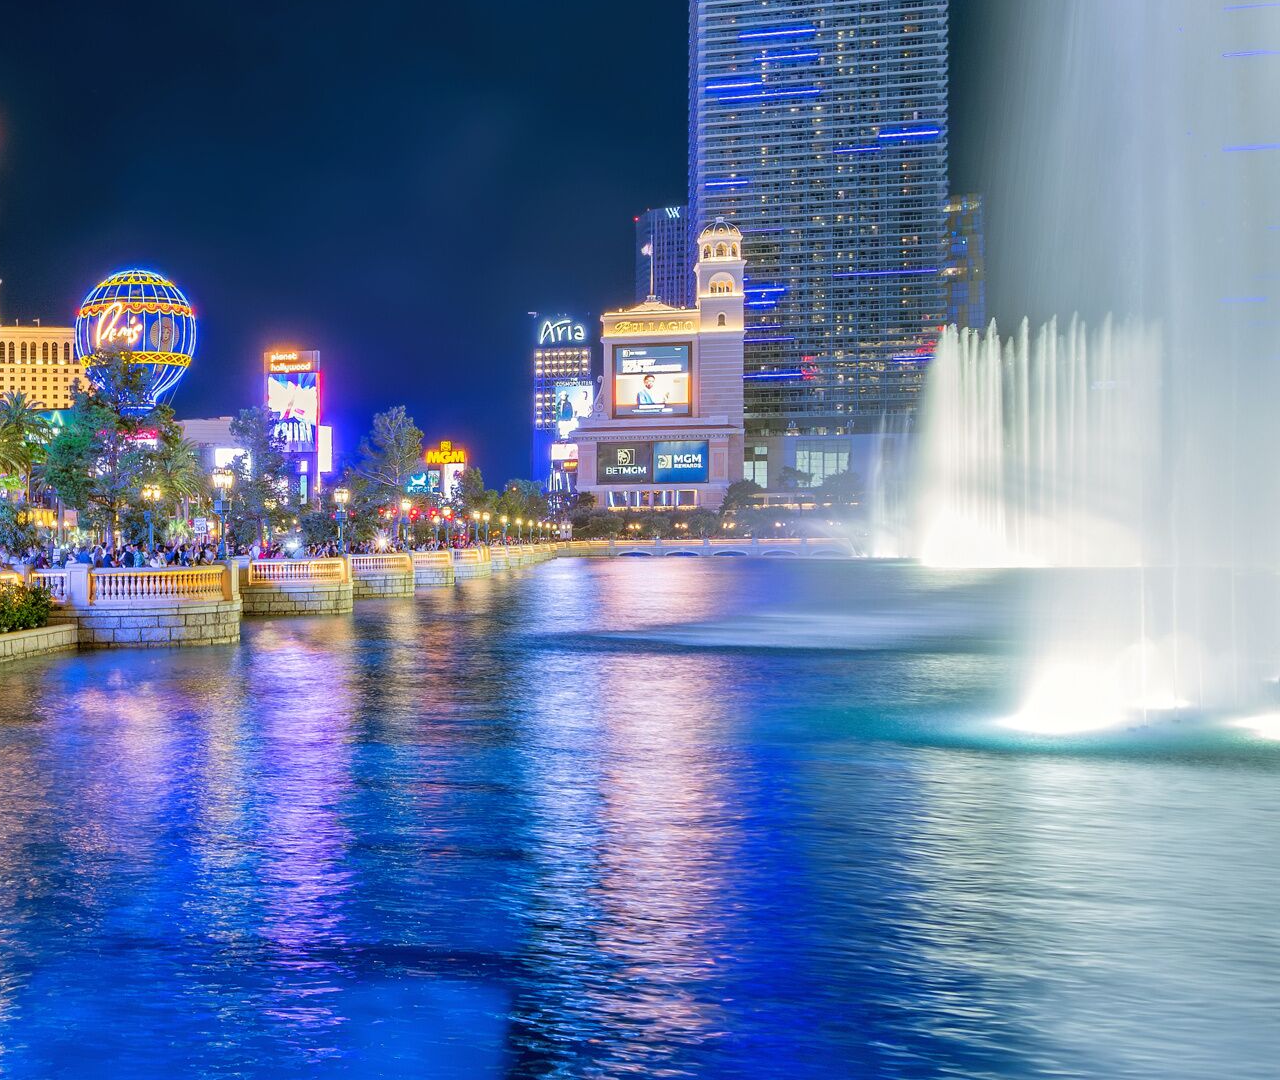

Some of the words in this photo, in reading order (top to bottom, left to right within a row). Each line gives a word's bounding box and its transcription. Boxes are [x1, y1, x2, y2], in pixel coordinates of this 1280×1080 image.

[96, 301, 144, 349] Paris
[614, 320, 695, 333] BELLAGIO
[539, 319, 585, 345] Aria
[271, 352, 297, 362] planet
[271, 361, 311, 373] hollywood
[426, 451, 465, 464] MGM
[673, 454, 702, 463] MGM
[605, 466, 647, 475] BETMGM
